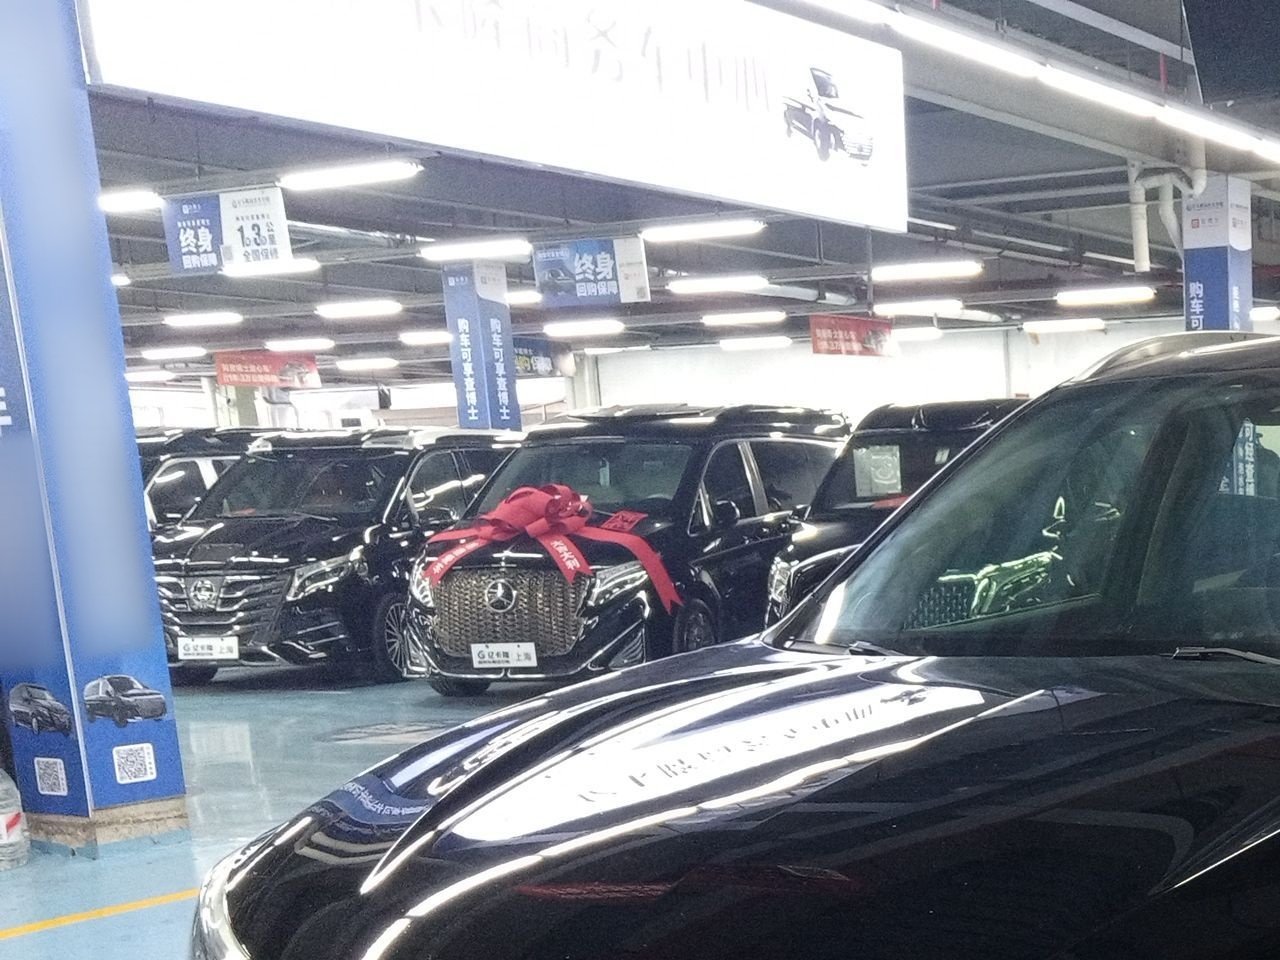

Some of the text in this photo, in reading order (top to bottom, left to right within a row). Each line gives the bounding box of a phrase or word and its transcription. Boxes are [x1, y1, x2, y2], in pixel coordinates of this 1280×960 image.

[179, 226, 213, 253] 终身
[574, 252, 615, 281] 终身
[576, 280, 619, 297] 回购保障
[1189, 281, 1205, 330] 购车可
[457, 318, 479, 420] 购车可享查博士
[489, 318, 511, 420] 购车可享查博士
